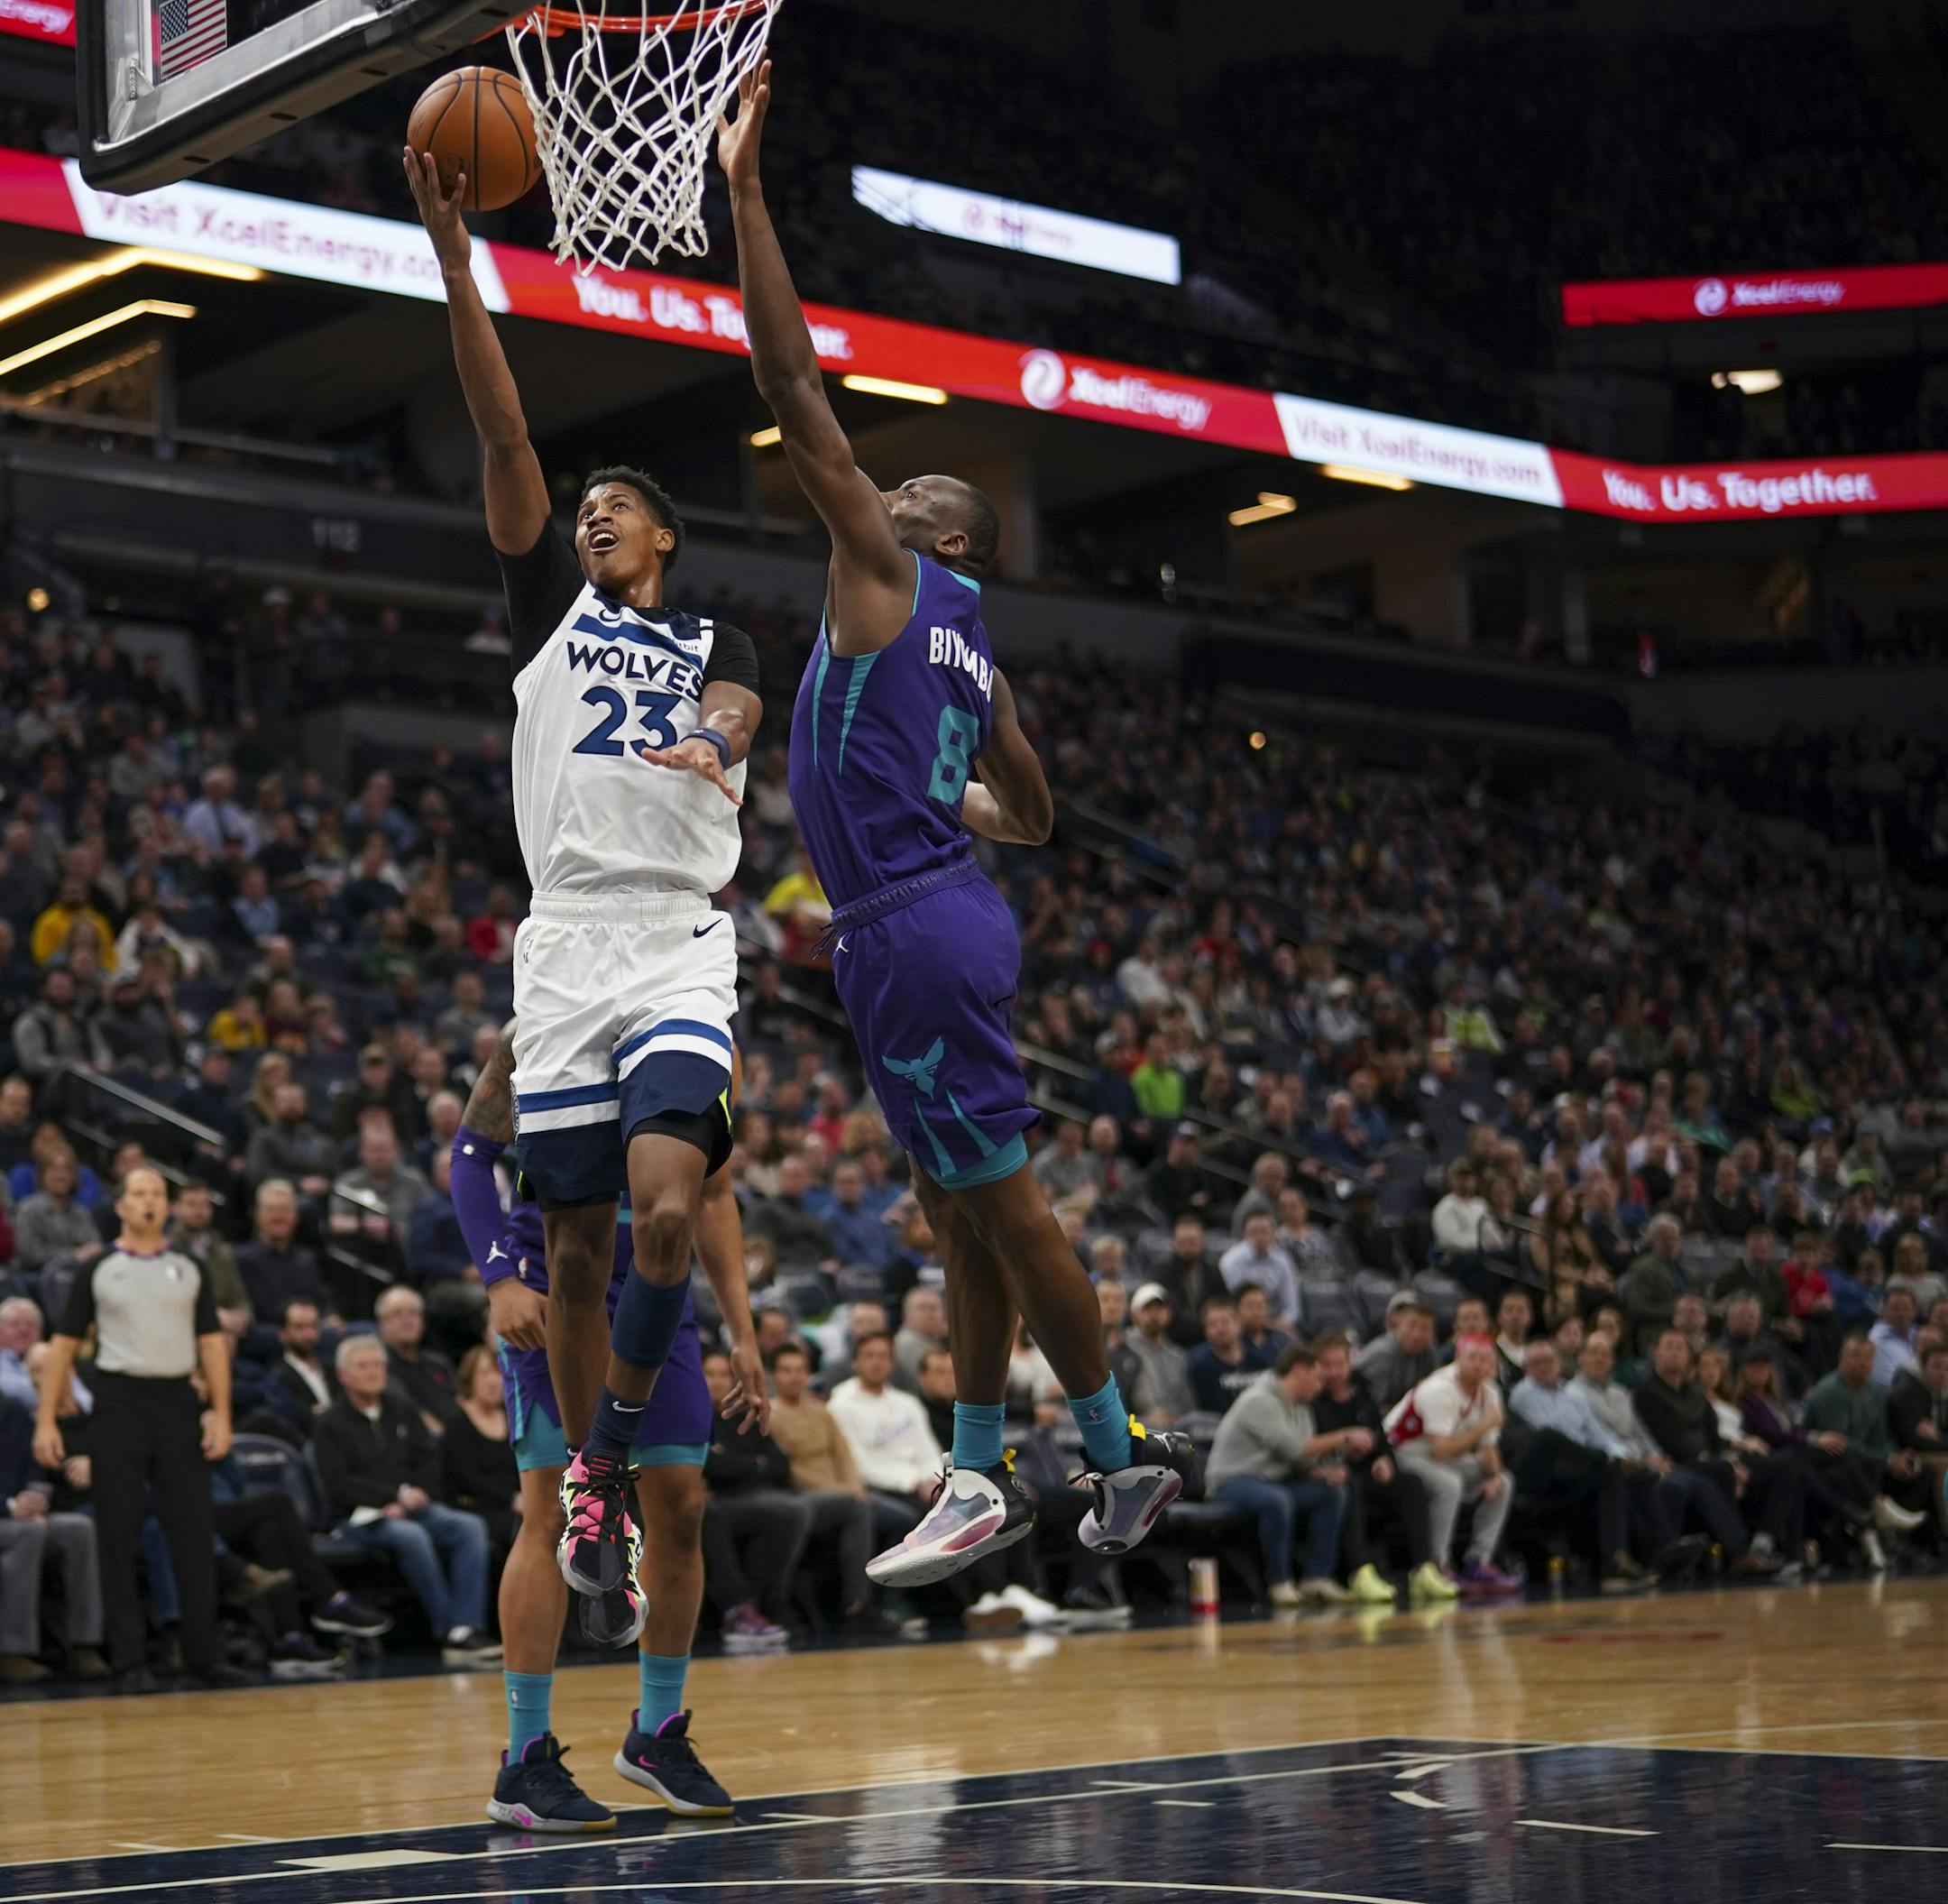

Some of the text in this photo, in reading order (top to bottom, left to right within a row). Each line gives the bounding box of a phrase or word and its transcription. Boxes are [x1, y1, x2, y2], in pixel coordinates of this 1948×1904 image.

[96, 192, 441, 281] Visit XcelEnergy.co
[573, 274, 853, 360] You. Us. Toer.
[1294, 414, 1348, 447] Visit
[1602, 467, 1878, 513] You. Us. Together.
[566, 641, 703, 703] WOLVES
[572, 685, 682, 758] 23
[927, 704, 979, 805] 8
